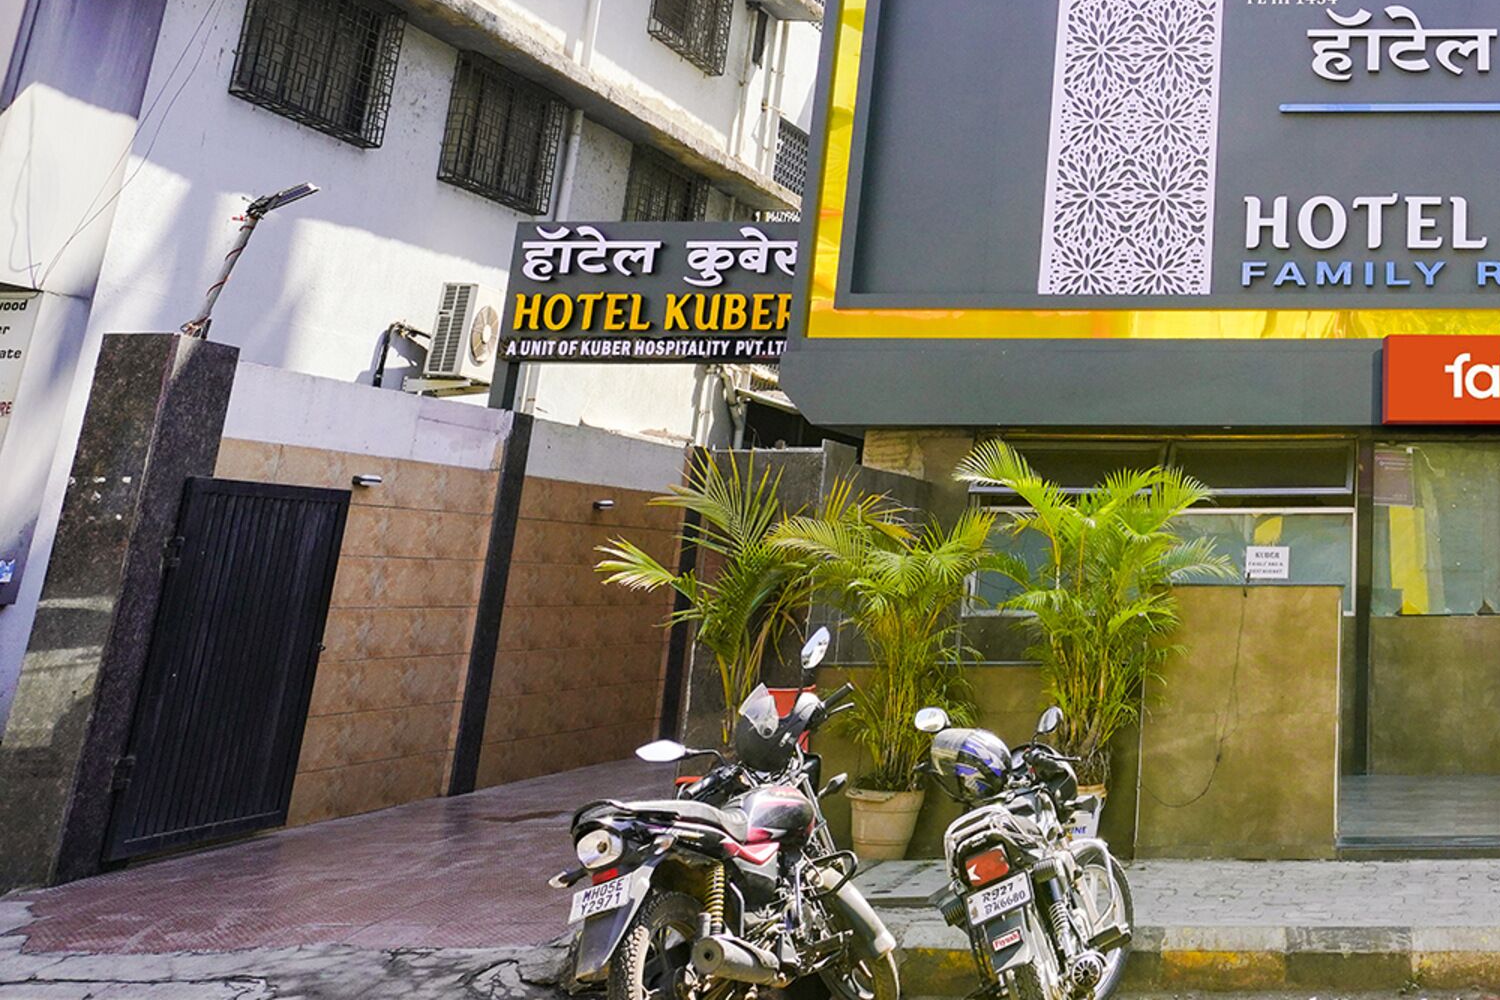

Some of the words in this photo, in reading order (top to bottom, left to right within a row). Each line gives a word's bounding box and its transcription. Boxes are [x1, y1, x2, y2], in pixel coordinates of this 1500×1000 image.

[1306, 5, 1498, 81] हॉटेल
[1243, 193, 1488, 250] HOTEL
[522, 226, 661, 281] हॉटेल
[1241, 260, 1447, 287] FAMILY
[512, 292, 652, 332] HOTEL
[506, 340, 517, 356] A
[520, 340, 556, 356] UNIT
[558, 340, 579, 356] OF
[580, 340, 631, 356] KUBER
[634, 340, 730, 356] HOSPITALITY
